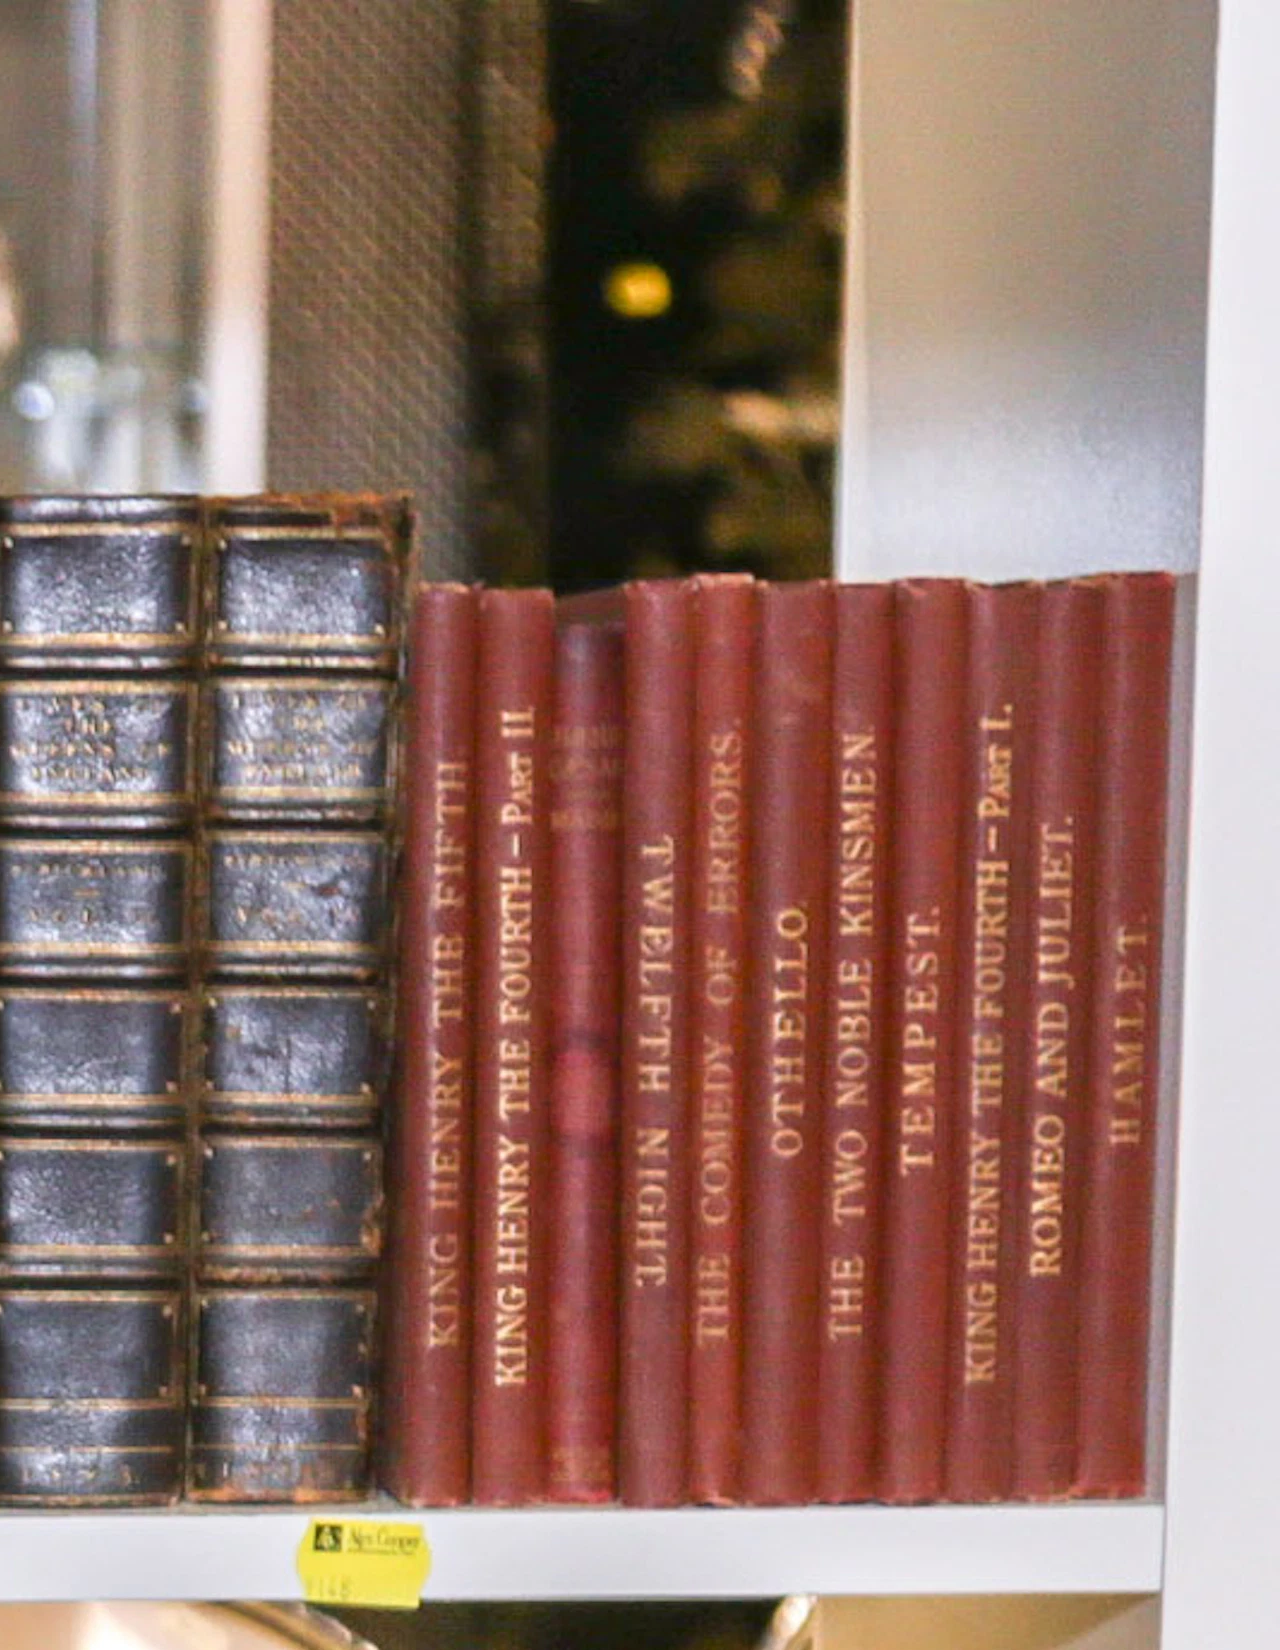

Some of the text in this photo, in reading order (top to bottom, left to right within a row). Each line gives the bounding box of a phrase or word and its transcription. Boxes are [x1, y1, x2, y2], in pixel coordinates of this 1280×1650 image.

[500, 866, 533, 1025] FOURTH
[639, 833, 675, 1093] TWELFTH
[704, 944, 738, 1006] OF
[973, 859, 1010, 1021] FOURTH
[428, 760, 467, 1347] KING HENRY THE FIFTH
[499, 1038, 531, 1122] THE
[835, 957, 873, 1108] NOBLE
[899, 906, 941, 1176] TEMPEST.
[971, 1032, 1004, 1118] THE
[1029, 815, 1075, 1279] ROMEO AND JULIET.
[700, 1034, 734, 1226] COMEDY
[833, 1129, 869, 1227] TWO
[497, 1134, 530, 1275] HENRY
[967, 1130, 1001, 1272] HENRY
[495, 1284, 527, 1387] KING
[696, 1253, 731, 1347] THE
[828, 1253, 865, 1343] THE
[964, 1280, 998, 1386] KING
